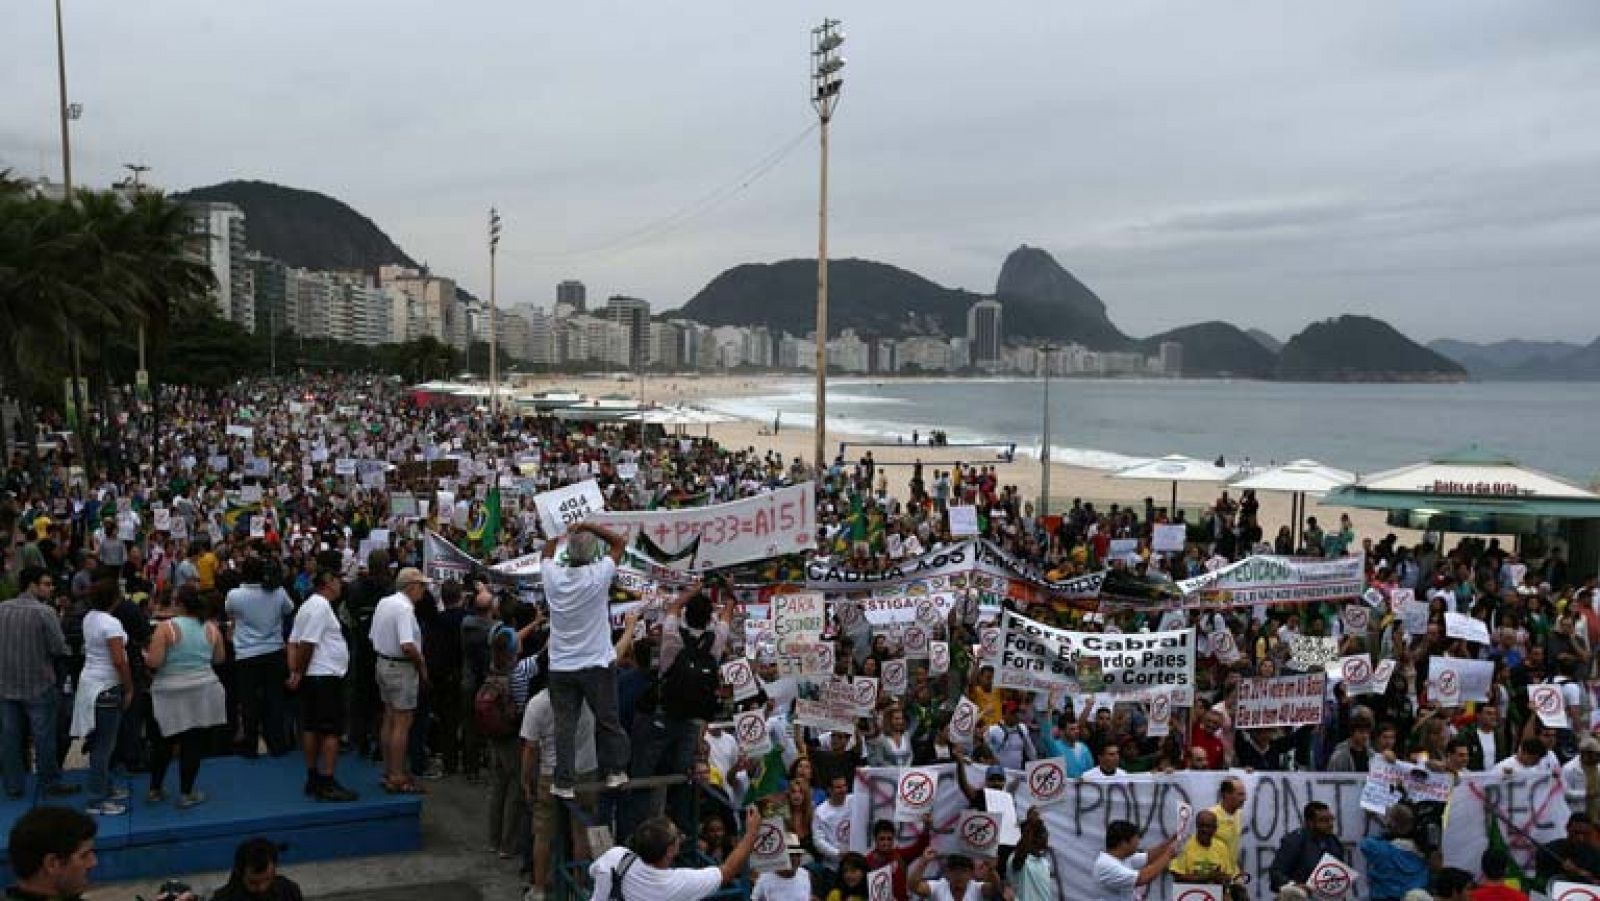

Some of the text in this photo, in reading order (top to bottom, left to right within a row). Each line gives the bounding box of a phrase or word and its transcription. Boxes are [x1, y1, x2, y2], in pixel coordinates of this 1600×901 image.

[1006, 634, 1187, 668] Fora Edrdo Paes
[1083, 633, 1188, 651] Cabral
[1003, 651, 1046, 672] Fora
[1122, 669, 1188, 685] Cortes
